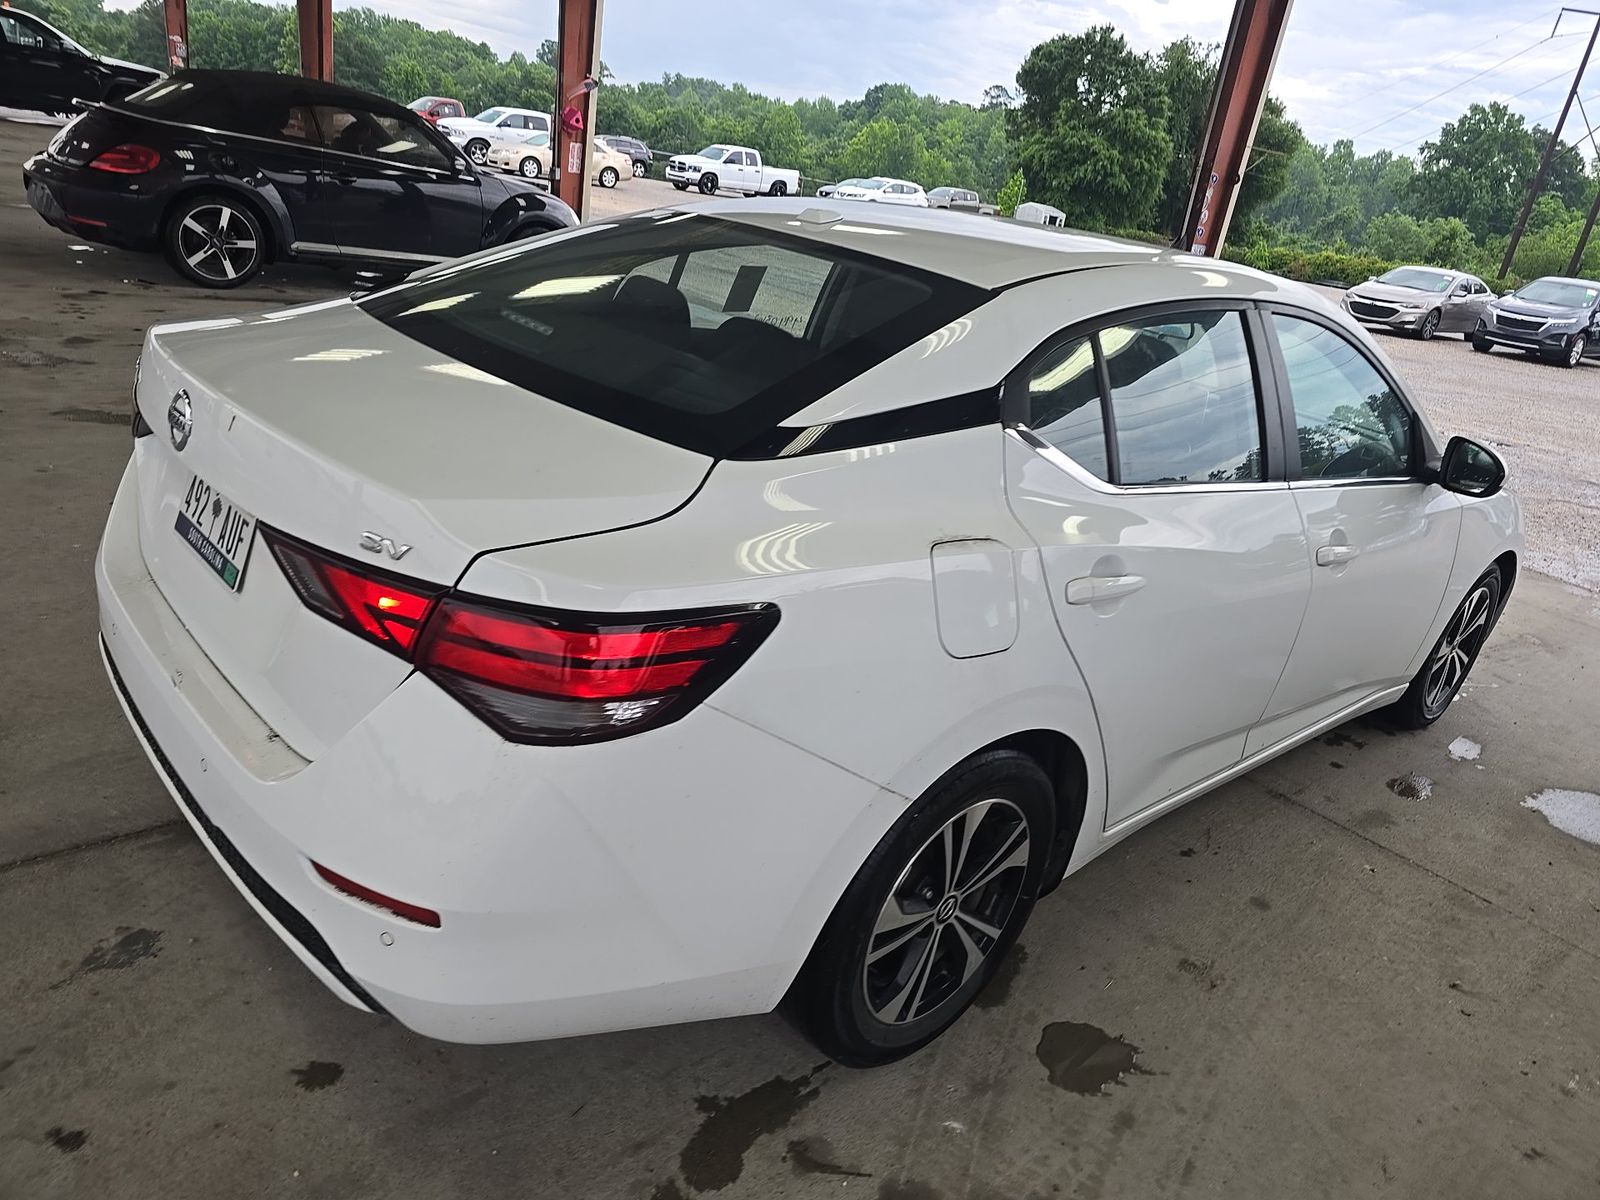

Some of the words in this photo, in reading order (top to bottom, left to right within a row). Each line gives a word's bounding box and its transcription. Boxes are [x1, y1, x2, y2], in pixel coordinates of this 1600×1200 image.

[185, 475, 211, 527] 492
[217, 504, 249, 560] AUF
[359, 530, 413, 560] SV
